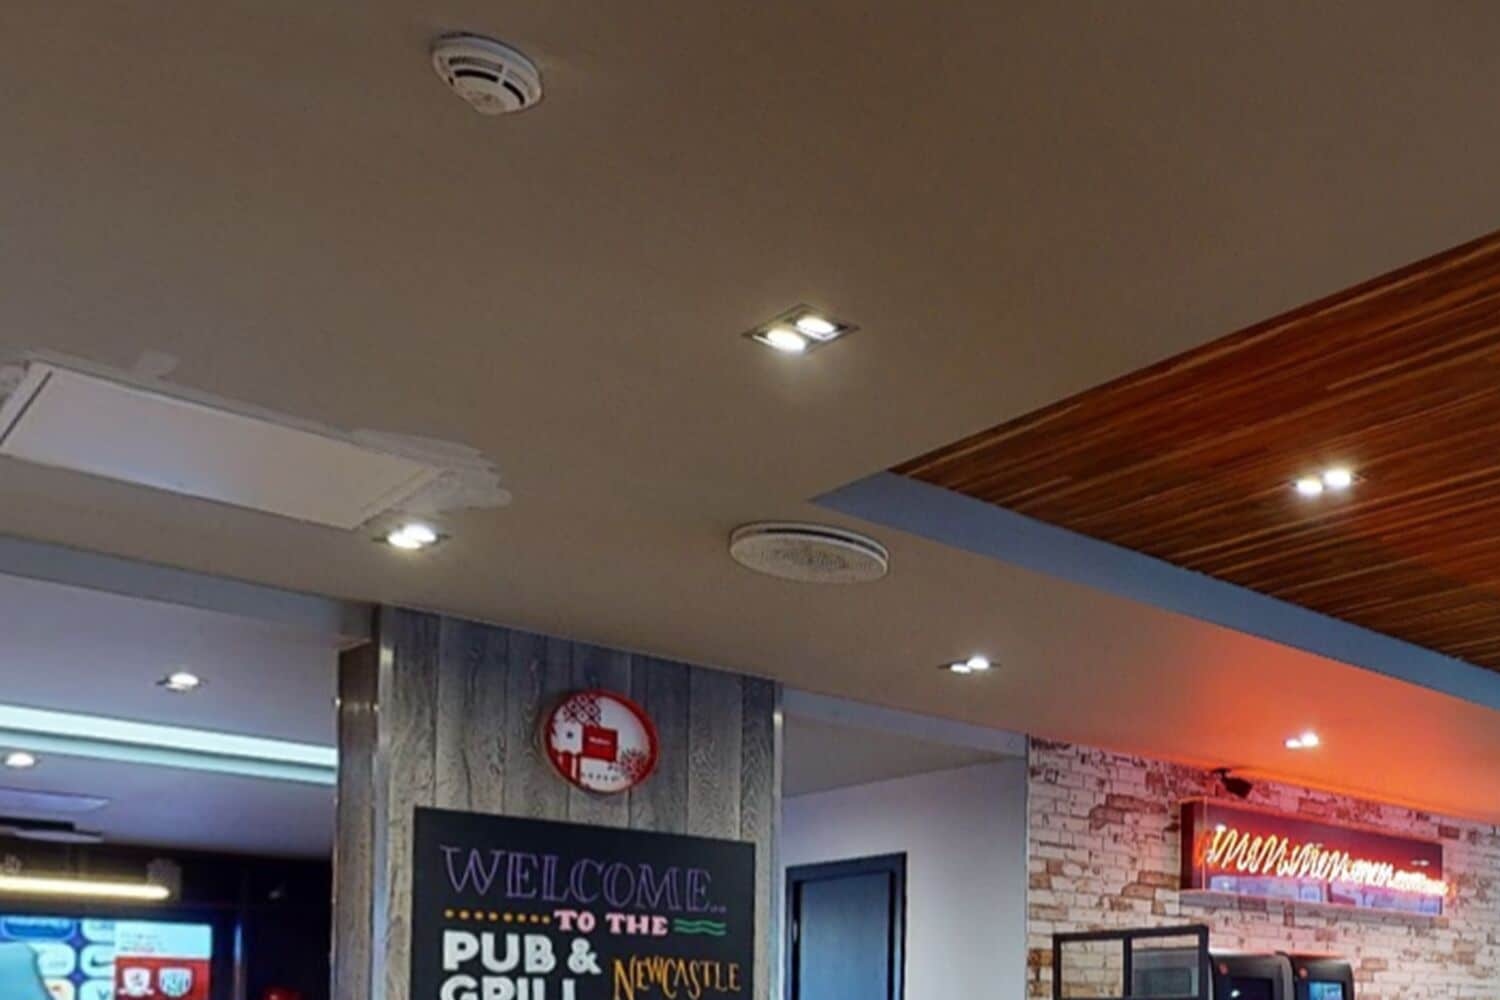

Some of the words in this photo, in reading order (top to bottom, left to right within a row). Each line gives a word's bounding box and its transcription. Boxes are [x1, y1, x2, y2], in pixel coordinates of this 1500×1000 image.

[554, 910, 596, 933] TO
[605, 913, 668, 936] THE
[443, 930, 556, 973] PUB
[567, 938, 602, 975] &
